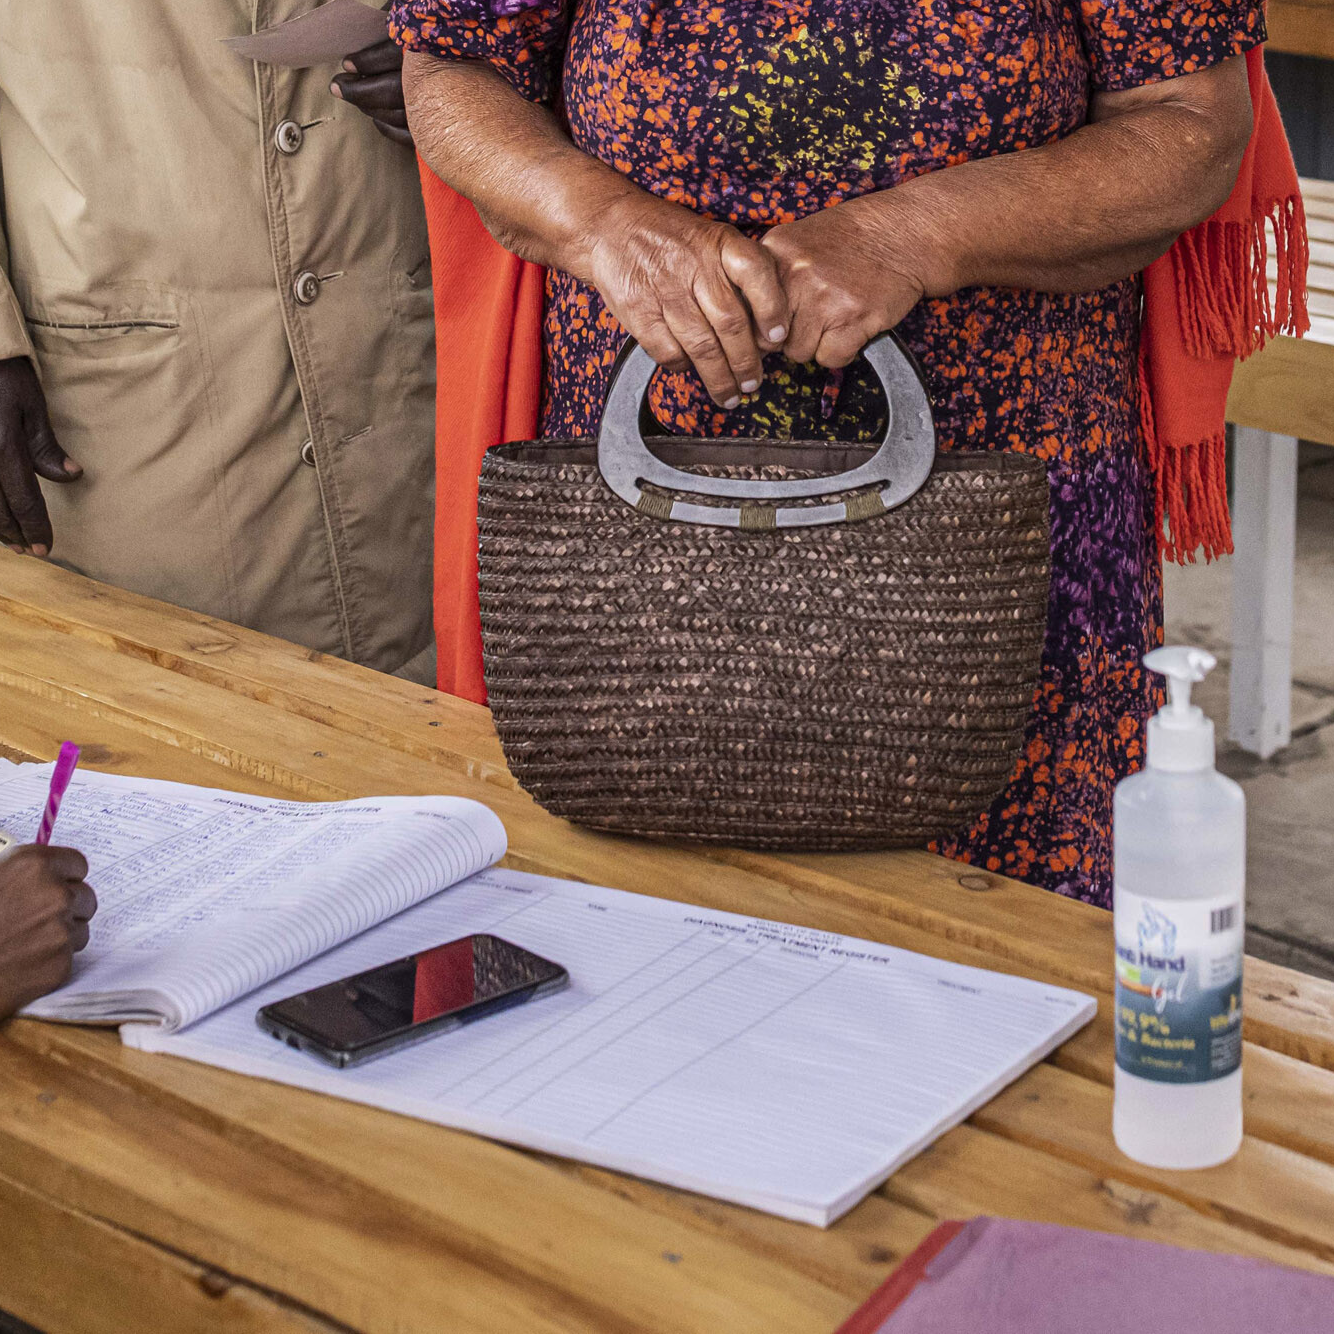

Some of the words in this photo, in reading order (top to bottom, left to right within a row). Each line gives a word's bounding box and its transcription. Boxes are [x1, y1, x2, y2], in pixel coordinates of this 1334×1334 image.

[213, 798, 268, 813] DIAGNOSIS
[758, 932, 826, 952] TREATMENT
[830, 948, 890, 964] REGISTER
[1140, 953, 1185, 972] Hand
